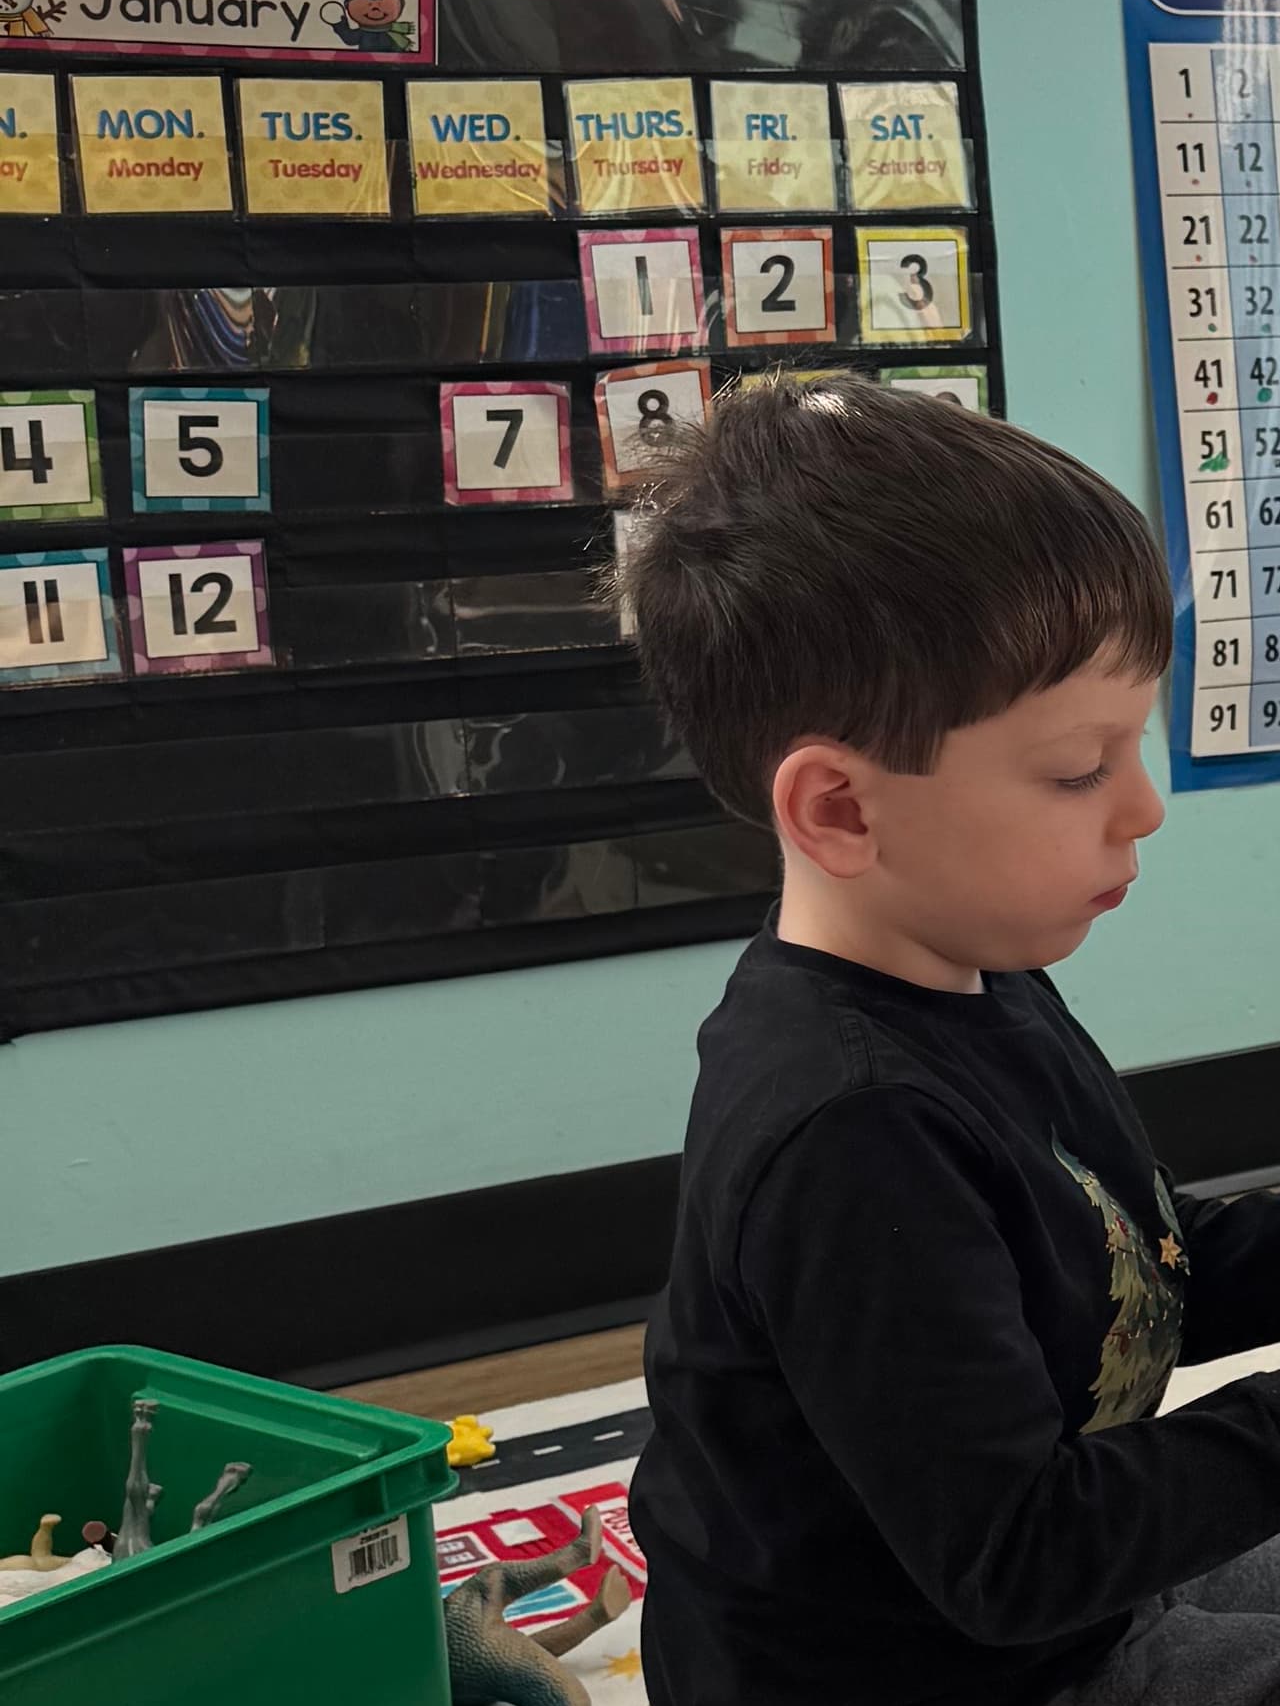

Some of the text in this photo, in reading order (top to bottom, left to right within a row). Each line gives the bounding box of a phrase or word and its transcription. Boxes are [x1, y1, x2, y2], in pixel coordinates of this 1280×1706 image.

[1178, 68, 1193, 98] 1
[1235, 68, 1252, 100] 2
[97, 108, 206, 140] MON.
[261, 111, 364, 142] TUES.
[431, 113, 522, 142] WED.
[575, 110, 695, 141] THURS.
[745, 113, 798, 141] FRI.
[871, 114, 935, 141] SAT.
[108, 155, 948, 183] Monday Tuesday Wednesday Thursday Friday Saturday
[1176, 142, 1207, 174] 11
[1233, 142, 1265, 173] 12
[1181, 215, 1212, 246] 21
[1238, 214, 1271, 245] 22
[635, 253, 935, 316] 1 2 3
[1187, 287, 1218, 318] 31
[1244, 285, 1276, 316] 32
[1194, 358, 1224, 389] 41
[1249, 356, 1280, 387] 42
[0, 389, 674, 484] 4 5 7 8
[1201, 429, 1229, 460] 51
[1205, 499, 1235, 530] 61
[1209, 569, 1238, 600] 71
[23, 571, 238, 644] 11 12
[1212, 638, 1240, 668] 81
[1209, 703, 1238, 732] 91
